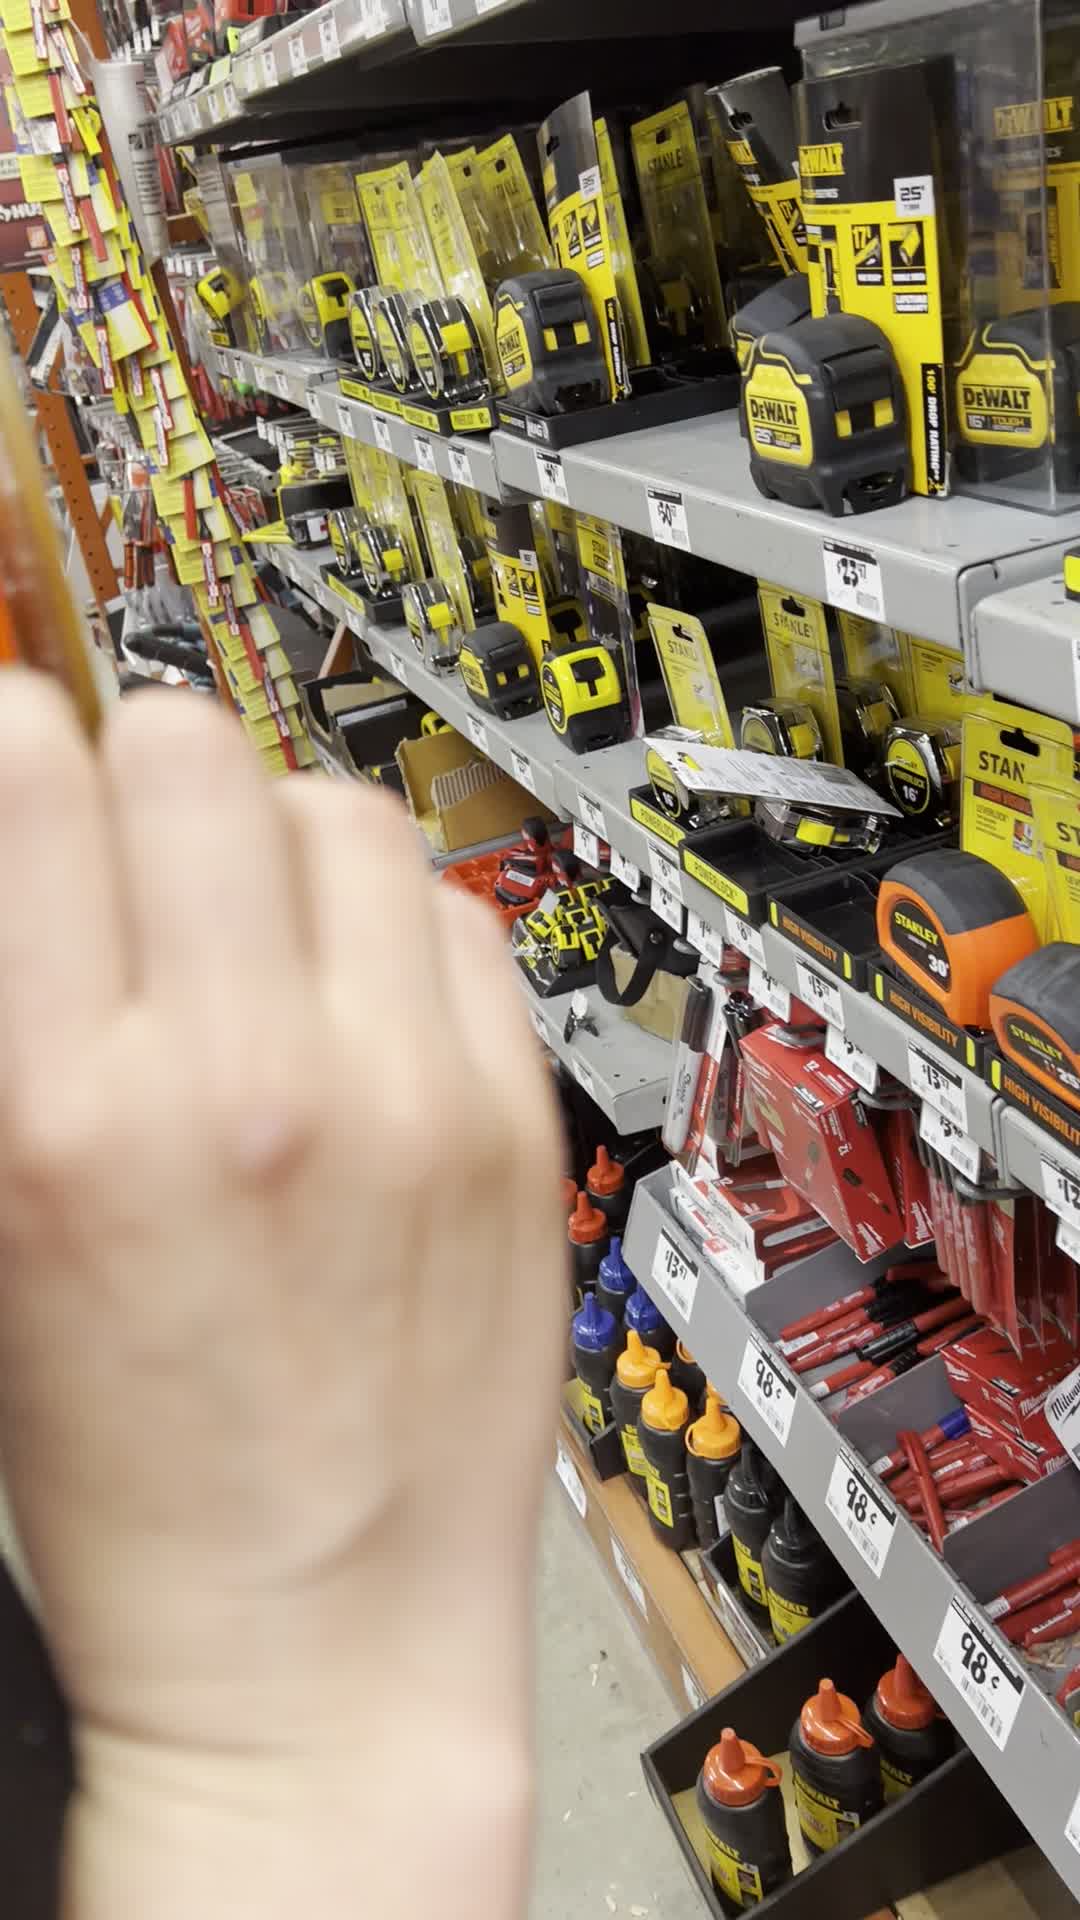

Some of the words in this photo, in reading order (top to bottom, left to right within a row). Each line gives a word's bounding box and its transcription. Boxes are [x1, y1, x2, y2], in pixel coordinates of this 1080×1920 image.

[750, 398, 798, 426] DEWALT
[927, 396, 938, 428] DROP
[963, 387, 1031, 410] DEWALT
[800, 924, 838, 963] VISIBILITY
[895, 911, 938, 945] STANLEY
[912, 1011, 958, 1049] VISIBILITY
[1010, 1024, 1062, 1060] STANLEY
[1003, 1075, 1030, 1106] HIGH
